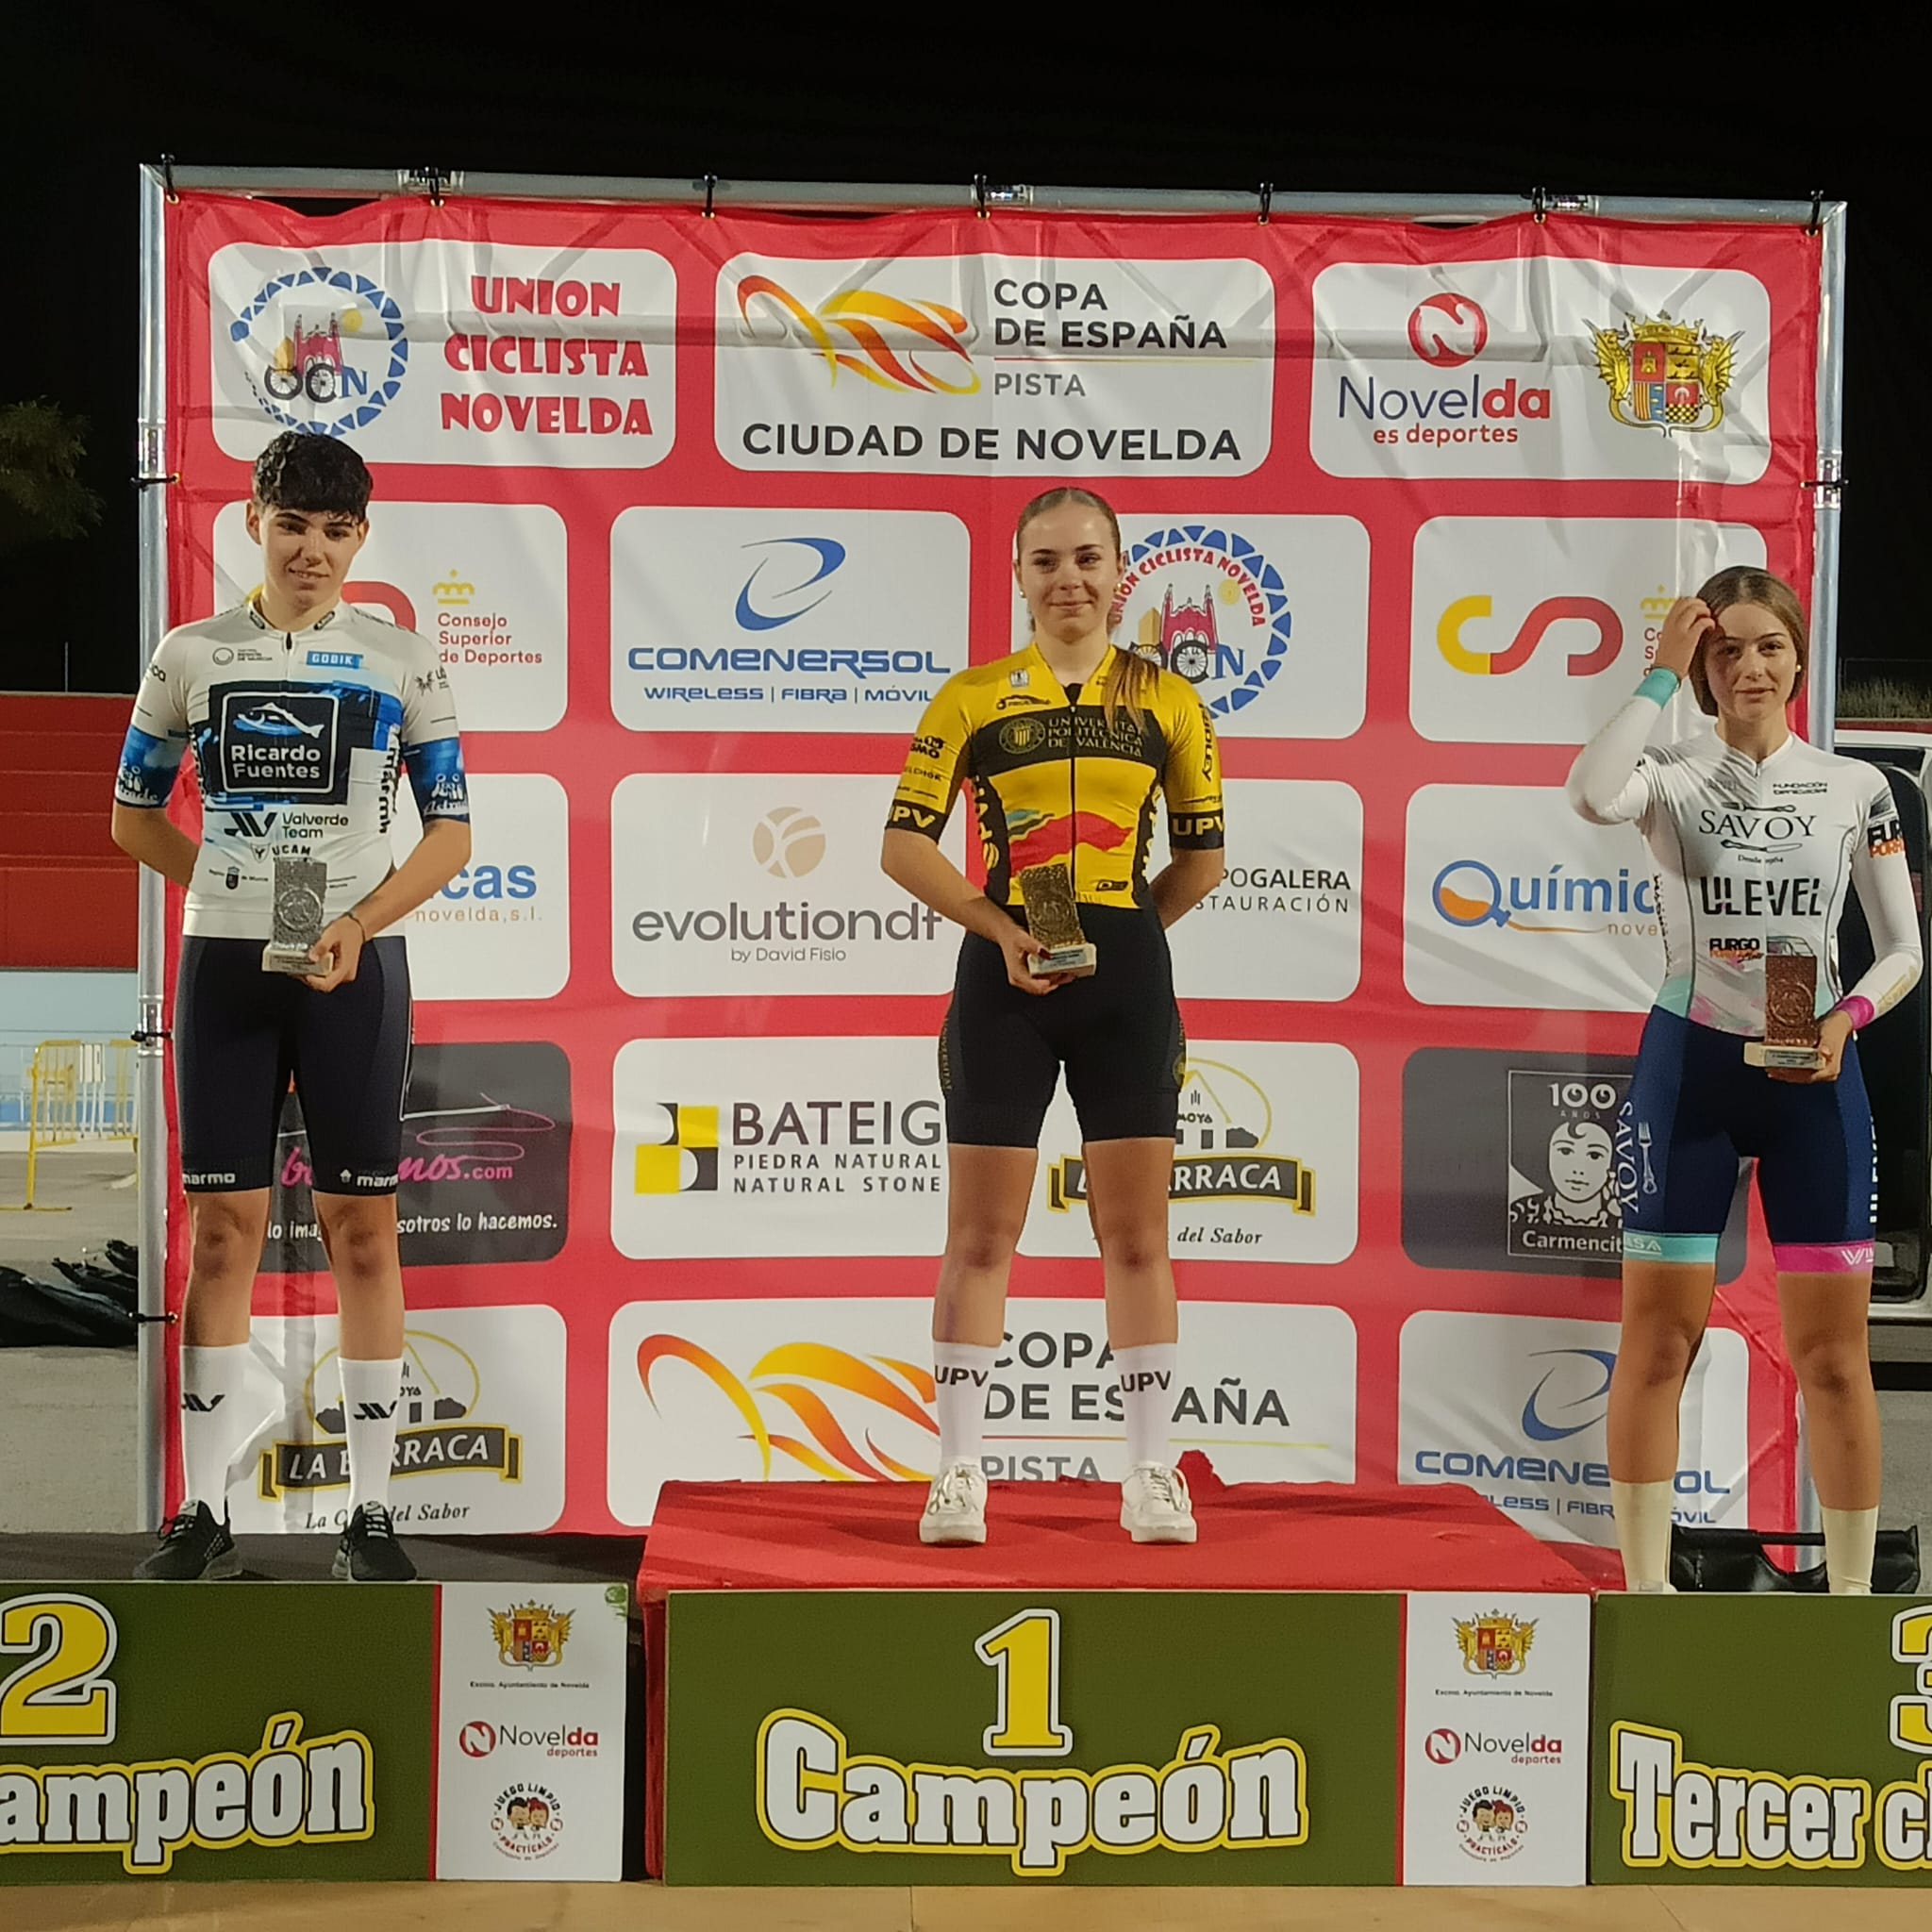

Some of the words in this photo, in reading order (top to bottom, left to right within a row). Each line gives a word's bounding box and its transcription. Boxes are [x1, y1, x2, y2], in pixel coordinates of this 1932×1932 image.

[472, 275, 621, 317] UNION
[993, 279, 1108, 311] COPA
[994, 318, 1045, 346] DE
[1061, 314, 1227, 349] ESPAÑA
[443, 334, 649, 376] CICLISTA
[994, 374, 1086, 396] PISTA
[1339, 374, 1551, 421] Novelda
[440, 392, 653, 436] NOVELDA
[743, 423, 923, 457] CIUDAD
[940, 427, 999, 459] DE
[1017, 428, 1241, 461] NOVELDA
[1373, 426, 1398, 444] es
[1407, 423, 1519, 448] deportes
[1139, 548, 1213, 575] CICLISTA
[1217, 558, 1266, 626] NOVELDA
[438, 613, 508, 630] Consejo
[438, 630, 511, 649] Superior
[440, 649, 459, 664] de
[464, 649, 542, 666] Deportes
[864, 685, 933, 703] MÓVIL
[230, 743, 322, 762] Ricardo
[232, 762, 321, 779] Fuentes
[283, 812, 349, 826] Valverde
[889, 806, 936, 828] PV
[1698, 809, 1817, 841] SAVOY
[282, 825, 323, 839] Team
[272, 843, 311, 857] UCAM
[1195, 893, 1348, 913] STAURACIÓN
[1432, 859, 1654, 927] Químic
[1700, 875, 1822, 917] ULEVEL
[632, 902, 942, 941] evolutiondf
[1607, 924, 1658, 936] nove
[731, 947, 751, 964] by
[756, 947, 806, 962] David
[809, 947, 847, 962] Fisio
[1709, 938, 1760, 951] FURGO
[1548, 1083, 1616, 1109] 100
[732, 1100, 941, 1146] BATEIG
[734, 1154, 819, 1170] PIEDRA
[834, 1153, 941, 1169] NATURAL
[1615, 1102, 1640, 1214] SAVOY
[734, 1177, 845, 1192] NATURAL
[863, 1176, 941, 1192] STONE
[1169, 1164, 1282, 1191] RRACA
[396, 1215, 450, 1234] sotros
[457, 1213, 472, 1232] lo
[477, 1211, 558, 1231] hacemos.
[1177, 1227, 1204, 1243] del
[1210, 1228, 1263, 1244] Sabor
[1523, 1230, 1623, 1253] Carmencit
[934, 1364, 989, 1388] UPV
[1121, 1371, 1172, 1392] UPV
[984, 1383, 1050, 1421] DE
[1072, 1377, 1291, 1426] ESAÑA
[289, 1453, 326, 1480] LA
[981, 1455, 1101, 1481] PISTA
[1415, 1451, 1730, 1494] COMENEOL
[306, 1513, 326, 1529] La
[418, 1503, 471, 1521] Sabor
[1567, 1501, 1615, 1520] FIBR
[0, 1592, 118, 1745] 2
[974, 1607, 1074, 1757] 1
[1463, 1689, 1511, 1697] Ayuntamiento
[500, 1724, 598, 1745] Novelda
[1464, 1732, 1562, 1753] Novelda
[547, 1746, 598, 1758] deportes
[1511, 1755, 1561, 1766] deportes
[0, 1711, 375, 1875] ampeón
[493, 1783, 525, 1811] JUEGO
[528, 1783, 560, 1811] LIMPIO
[756, 1708, 1308, 1877] Campeón
[1459, 1786, 1490, 1813] JUEGO
[1492, 1785, 1525, 1813] LIMPIO
[1609, 1720, 1872, 1869] Tercer
